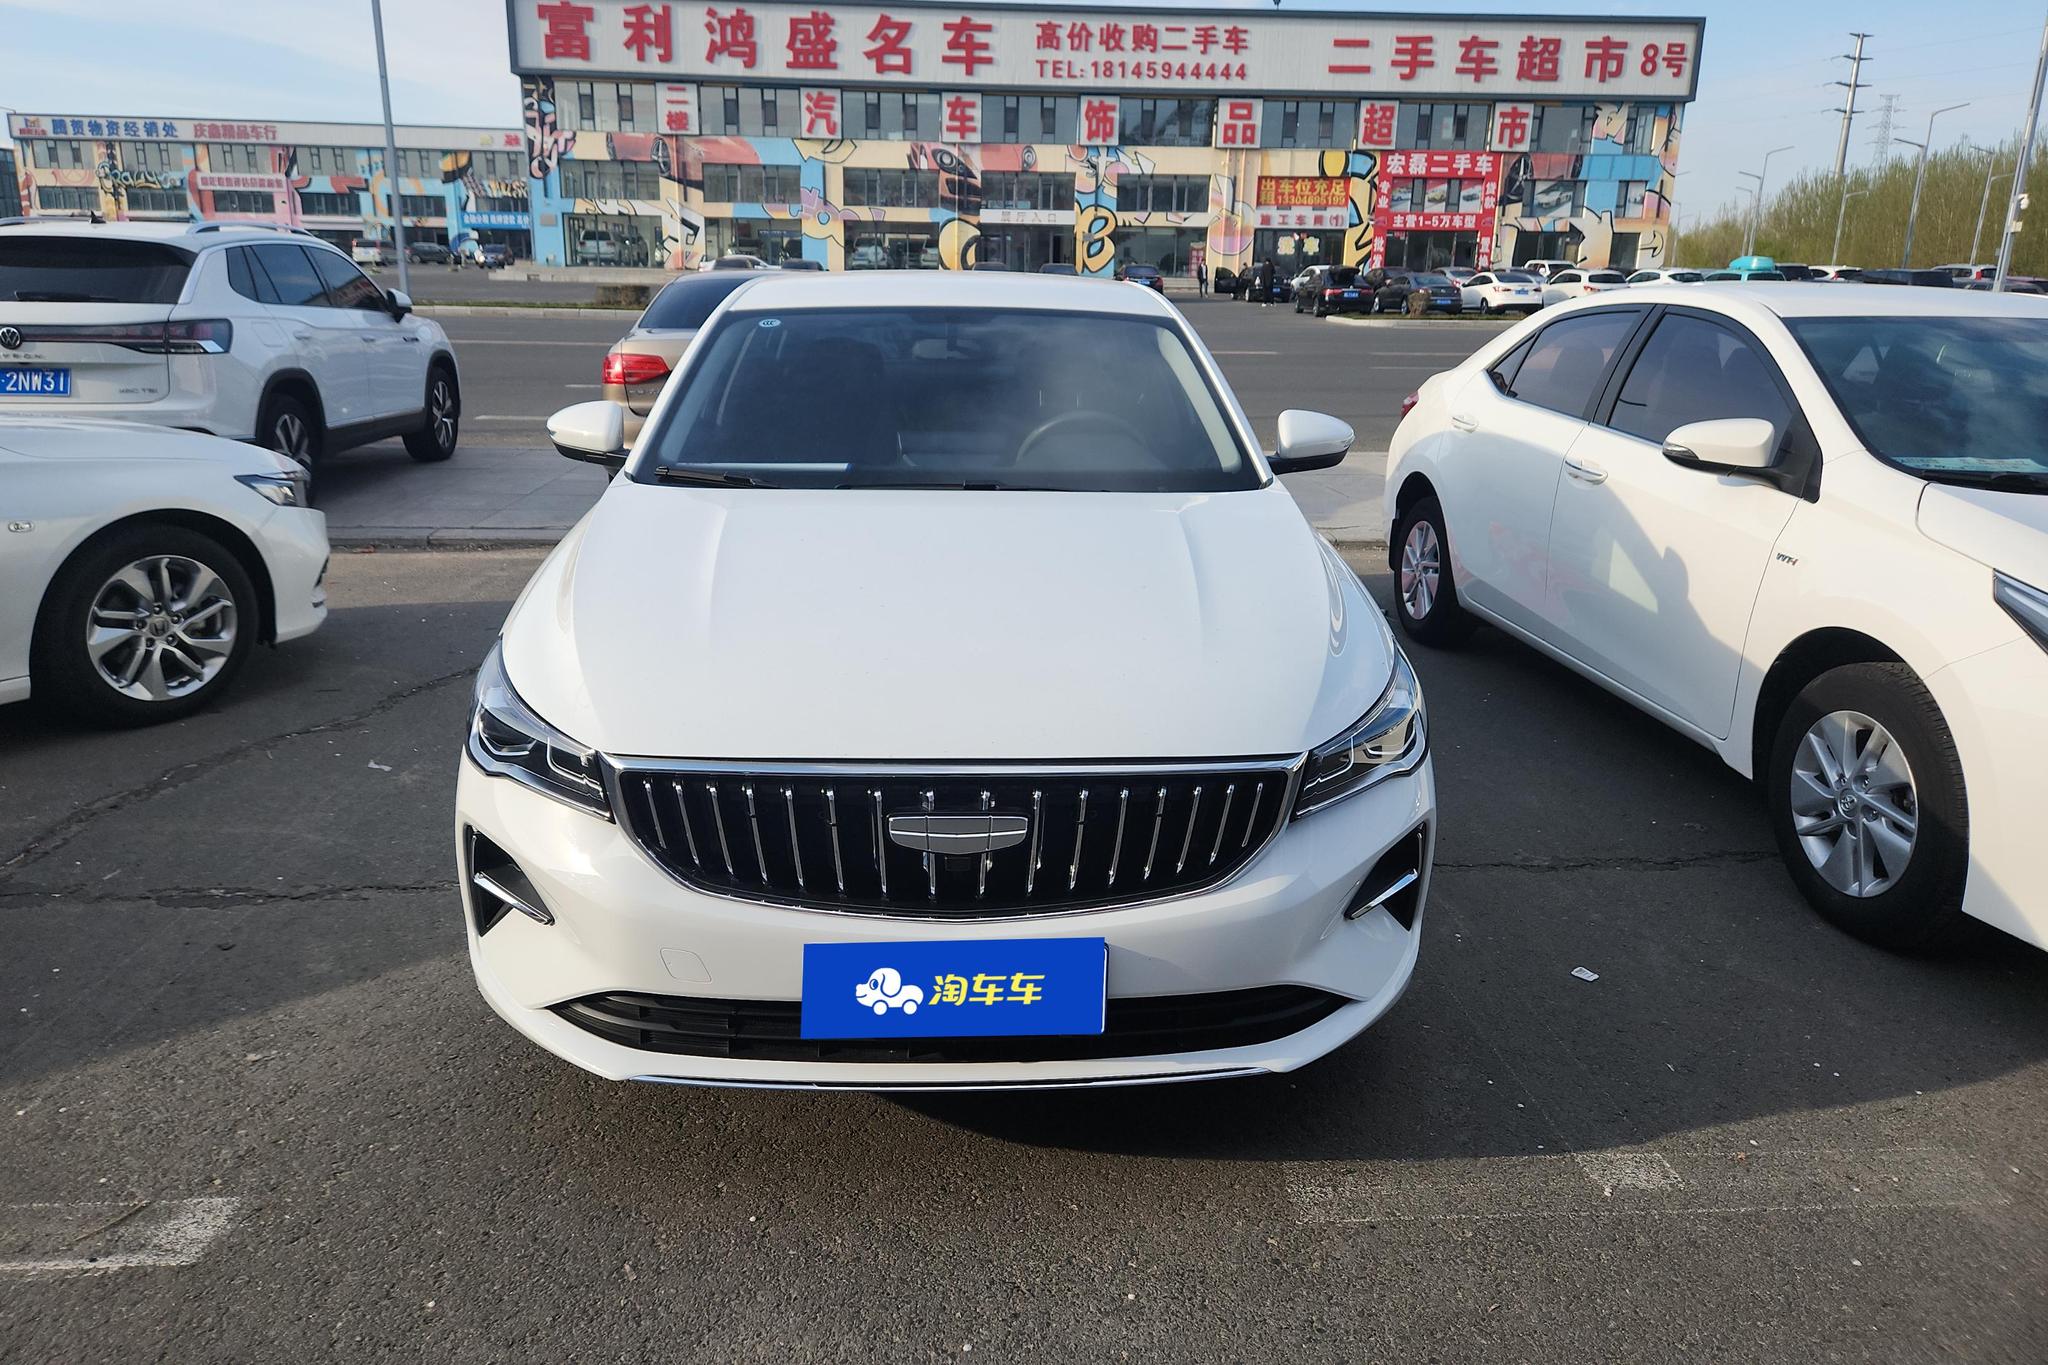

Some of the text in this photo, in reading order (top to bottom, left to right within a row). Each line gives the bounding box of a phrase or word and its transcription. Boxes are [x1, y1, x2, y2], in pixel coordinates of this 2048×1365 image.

[538, 3, 995, 76] 富利鸿盛名车
[1035, 21, 1249, 54] 高价收购二手车
[1035, 60, 1248, 80] TEL:18145944444
[1328, 35, 1688, 83] 二手车超市8号
[1386, 152, 1494, 176] 宏磊二手车
